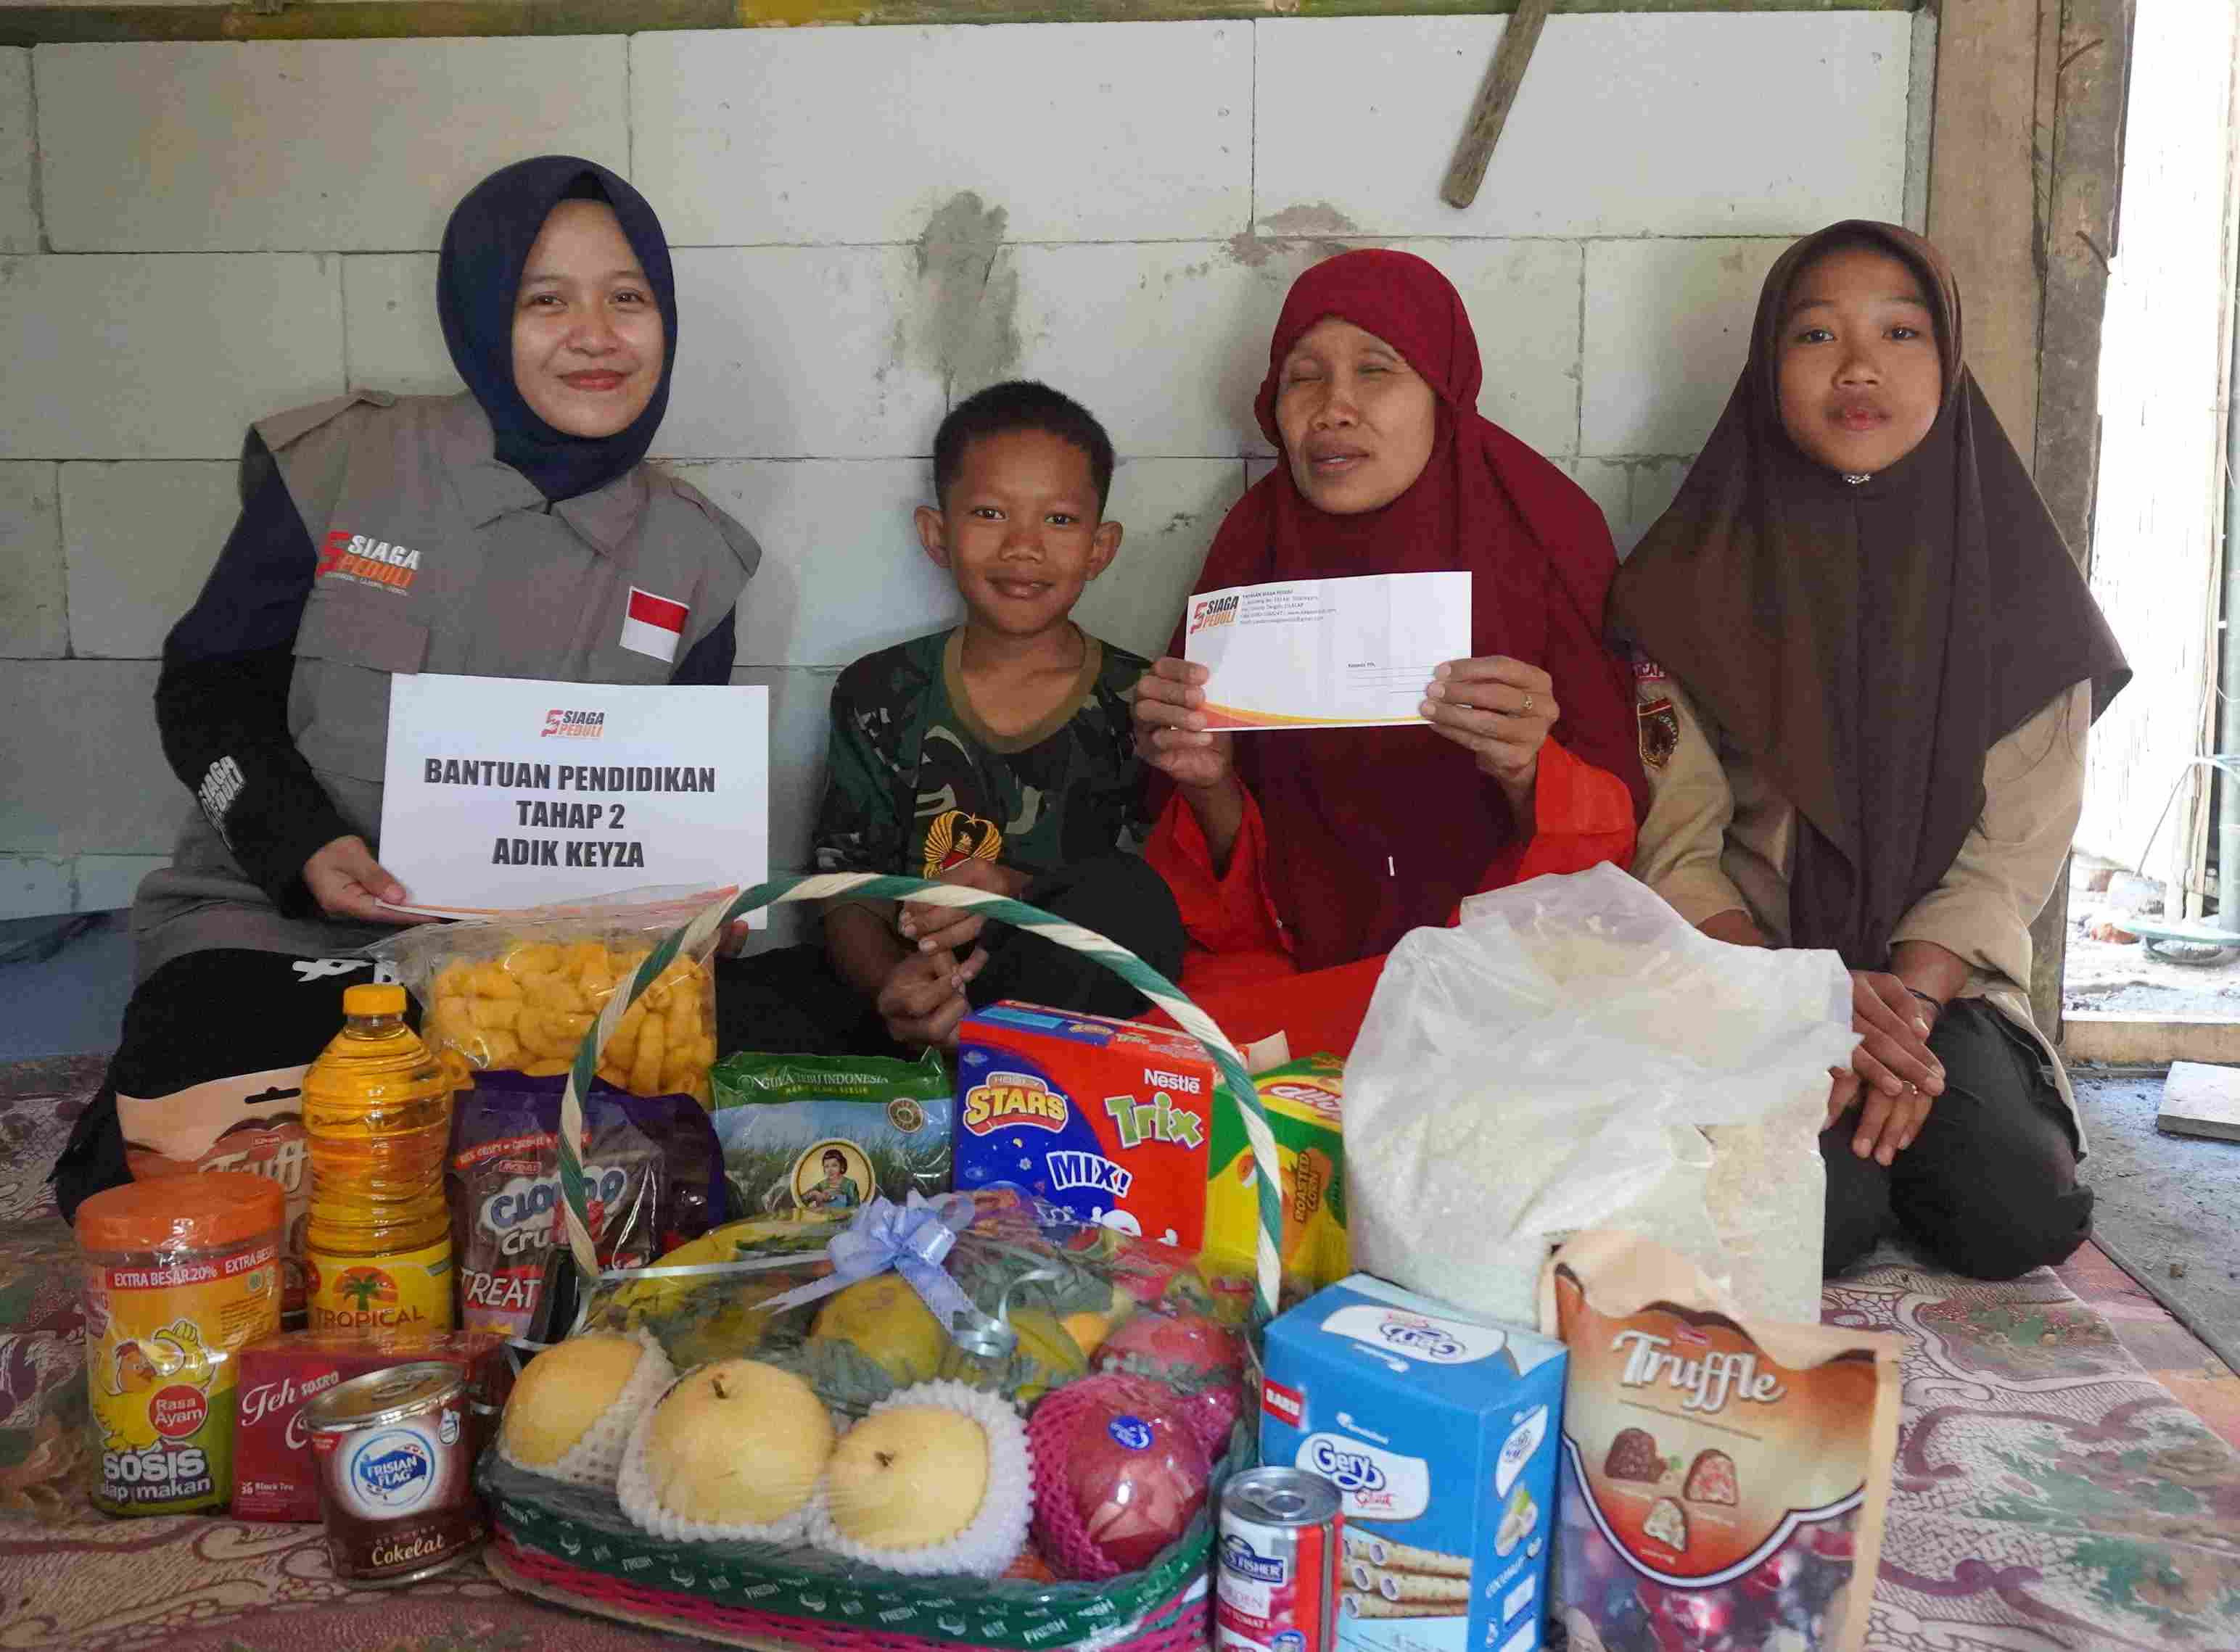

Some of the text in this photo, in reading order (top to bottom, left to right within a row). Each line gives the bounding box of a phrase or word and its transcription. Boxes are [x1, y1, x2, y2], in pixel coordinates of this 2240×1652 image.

[348, 534, 421, 570] SIAGA
[1207, 595, 1240, 615] SIAGA
[563, 710, 604, 724] SIAGA
[424, 758, 715, 793] BANTUAN PENDIDIKAN
[516, 800, 625, 830] TAHAP 2
[492, 838, 645, 867] ADIK KEYZA
[967, 1088, 1066, 1125] STARS
[1104, 1091, 1204, 1148] Trix
[1045, 1150, 1132, 1199] MIX!
[1293, 1149, 1311, 1224] ROASTED
[1306, 1171, 1321, 1213] CORN
[225, 1252, 256, 1273] EXTRA
[114, 1272, 149, 1287] EXTRA
[460, 1266, 540, 1309] TREAT
[316, 1305, 425, 1328] TROPICAL
[1613, 1330, 1787, 1412] Truffle
[155, 1397, 197, 1411] Rasa
[241, 1378, 297, 1427] Teh
[155, 1408, 202, 1427] Ayam
[103, 1449, 206, 1482] SOSIS
[366, 1455, 418, 1477] FRISIAN
[377, 1469, 411, 1487] FLAG
[1312, 1439, 1386, 1492] Gery
[136, 1477, 210, 1499] makan
[371, 1533, 445, 1567] Cokelat
[1236, 1557, 1282, 1579] FISHER
[744, 1583, 780, 1601] FRESH
[878, 1606, 918, 1624] FRESH
[1022, 1618, 1068, 1645] FRESH
